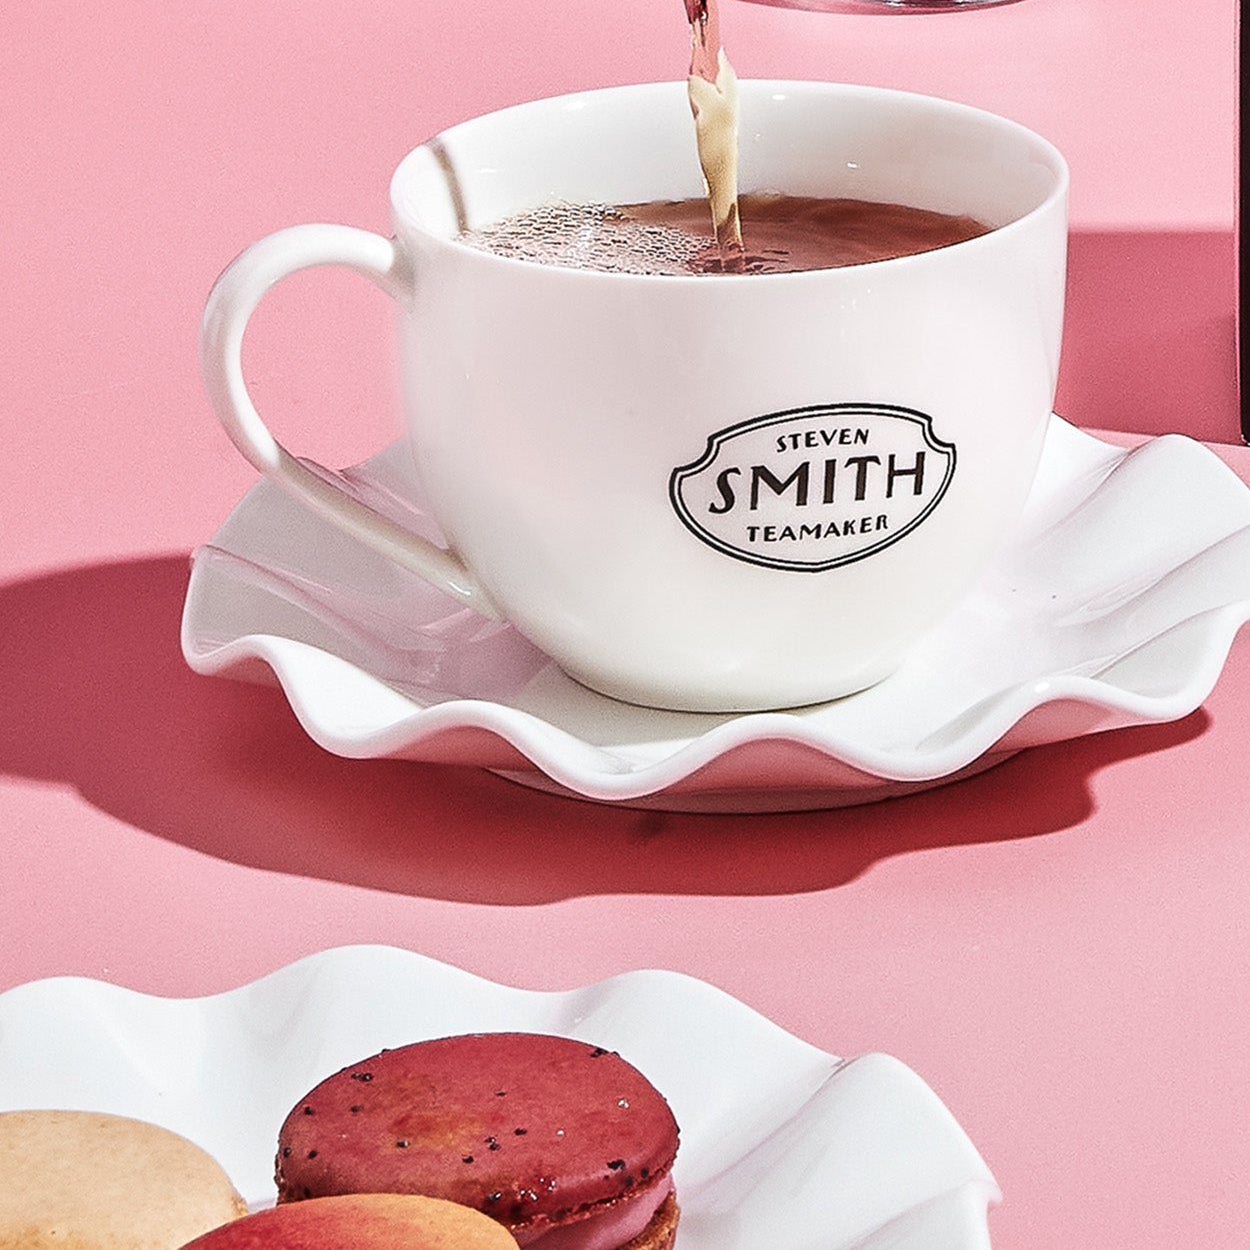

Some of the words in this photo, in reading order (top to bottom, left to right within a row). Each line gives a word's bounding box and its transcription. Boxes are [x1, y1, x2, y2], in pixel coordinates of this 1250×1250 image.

[776, 428, 869, 453] STEVEN
[708, 451, 926, 515] SMITH
[746, 514, 889, 542] TEAMAKER
